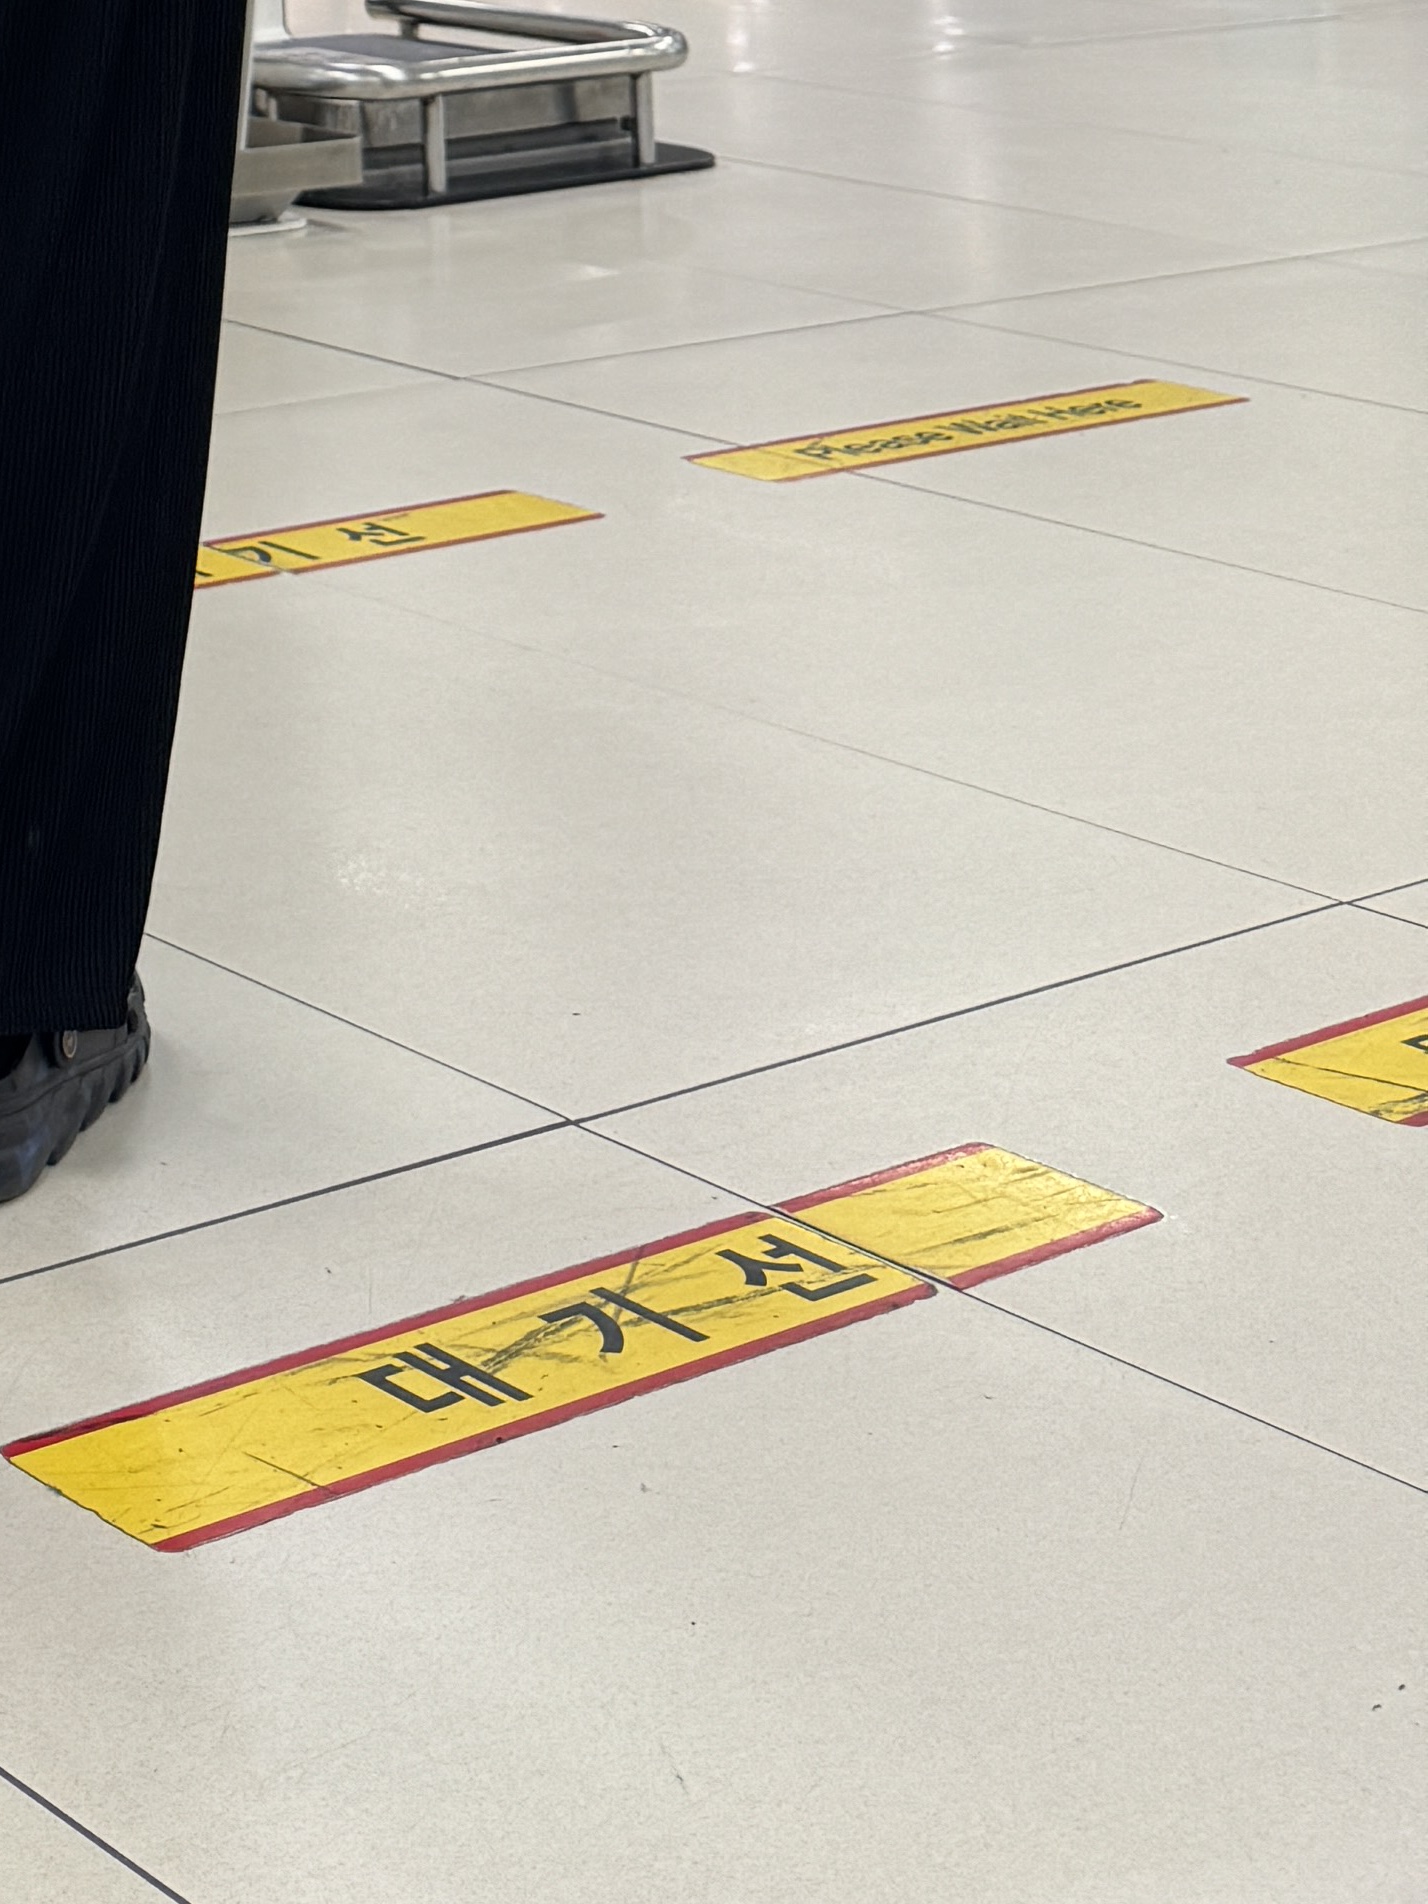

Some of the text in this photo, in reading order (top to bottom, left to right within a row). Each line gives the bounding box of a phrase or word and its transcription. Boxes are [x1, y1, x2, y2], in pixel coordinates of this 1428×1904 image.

[794, 398, 1142, 460] Please Wait Here
[335, 521, 427, 547] 선
